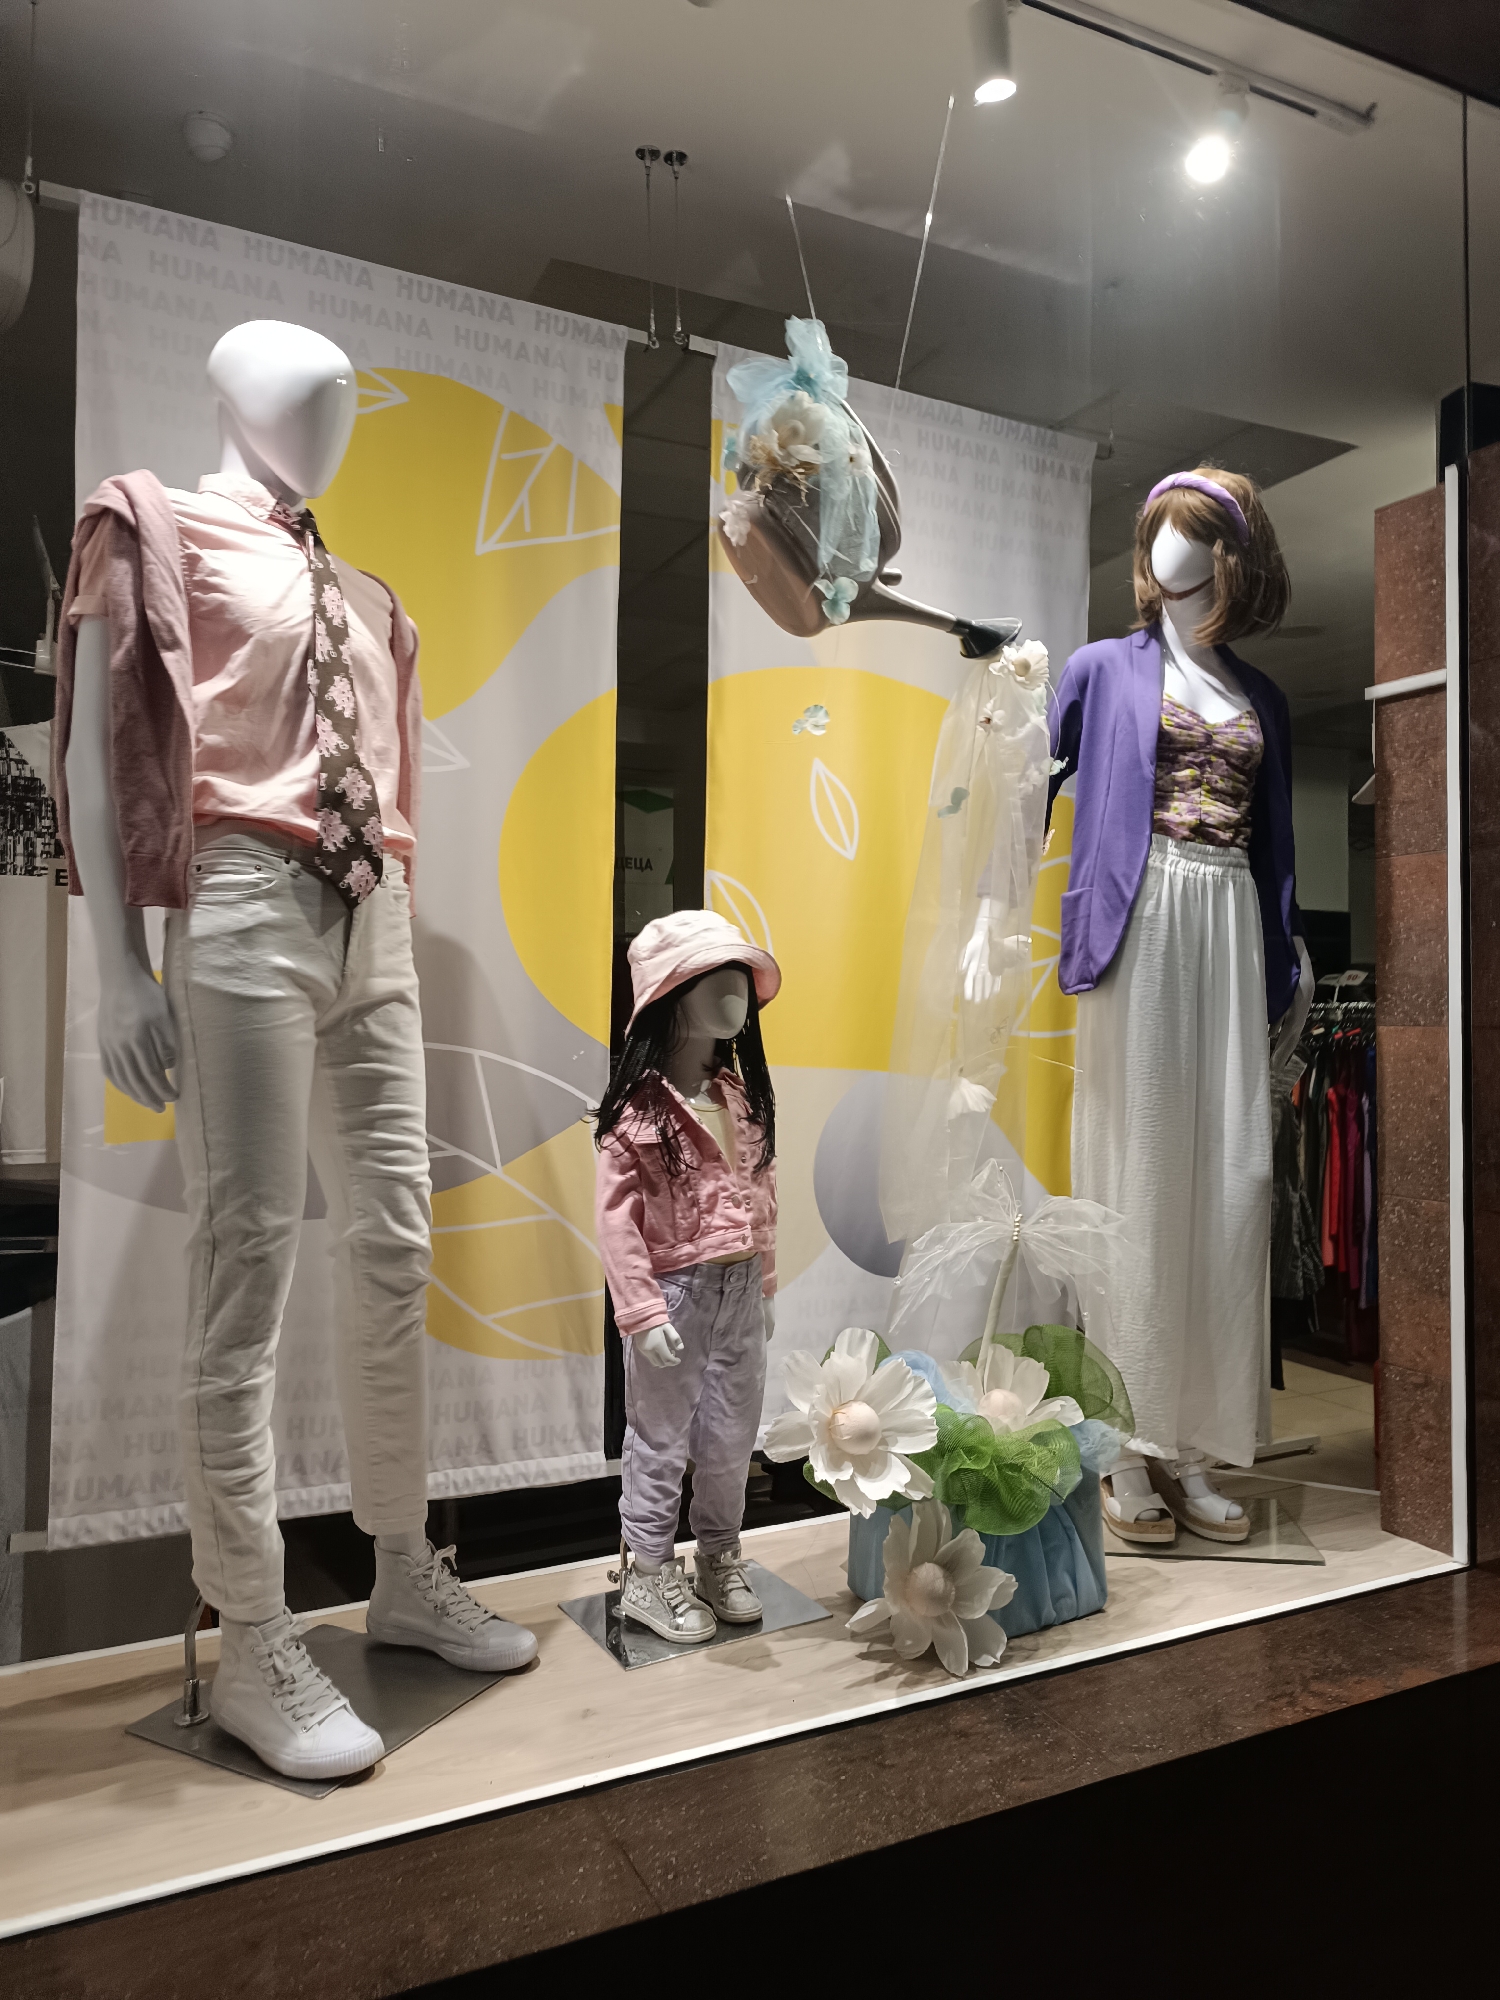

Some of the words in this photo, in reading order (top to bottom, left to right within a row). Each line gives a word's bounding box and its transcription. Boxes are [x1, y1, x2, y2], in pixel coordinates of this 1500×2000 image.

[80, 193, 220, 251] HUMANA
[243, 236, 374, 290] HUMANA
[396, 275, 515, 325] HUMANA
[80, 271, 219, 326] HUMANA
[394, 346, 512, 394] HUMANA
[149, 250, 285, 305] HUMANA
[307, 290, 433, 340] HUMANA
[454, 325, 567, 373] HUMANA
[917, 428, 1001, 465] HUMANA
[1015, 452, 1091, 485] HUMANA
[978, 411, 1059, 449] HUMANA
[903, 454, 960, 485] MANA
[974, 472, 1054, 506] HUMANA
[433, 1391, 548, 1426] HUMANA
